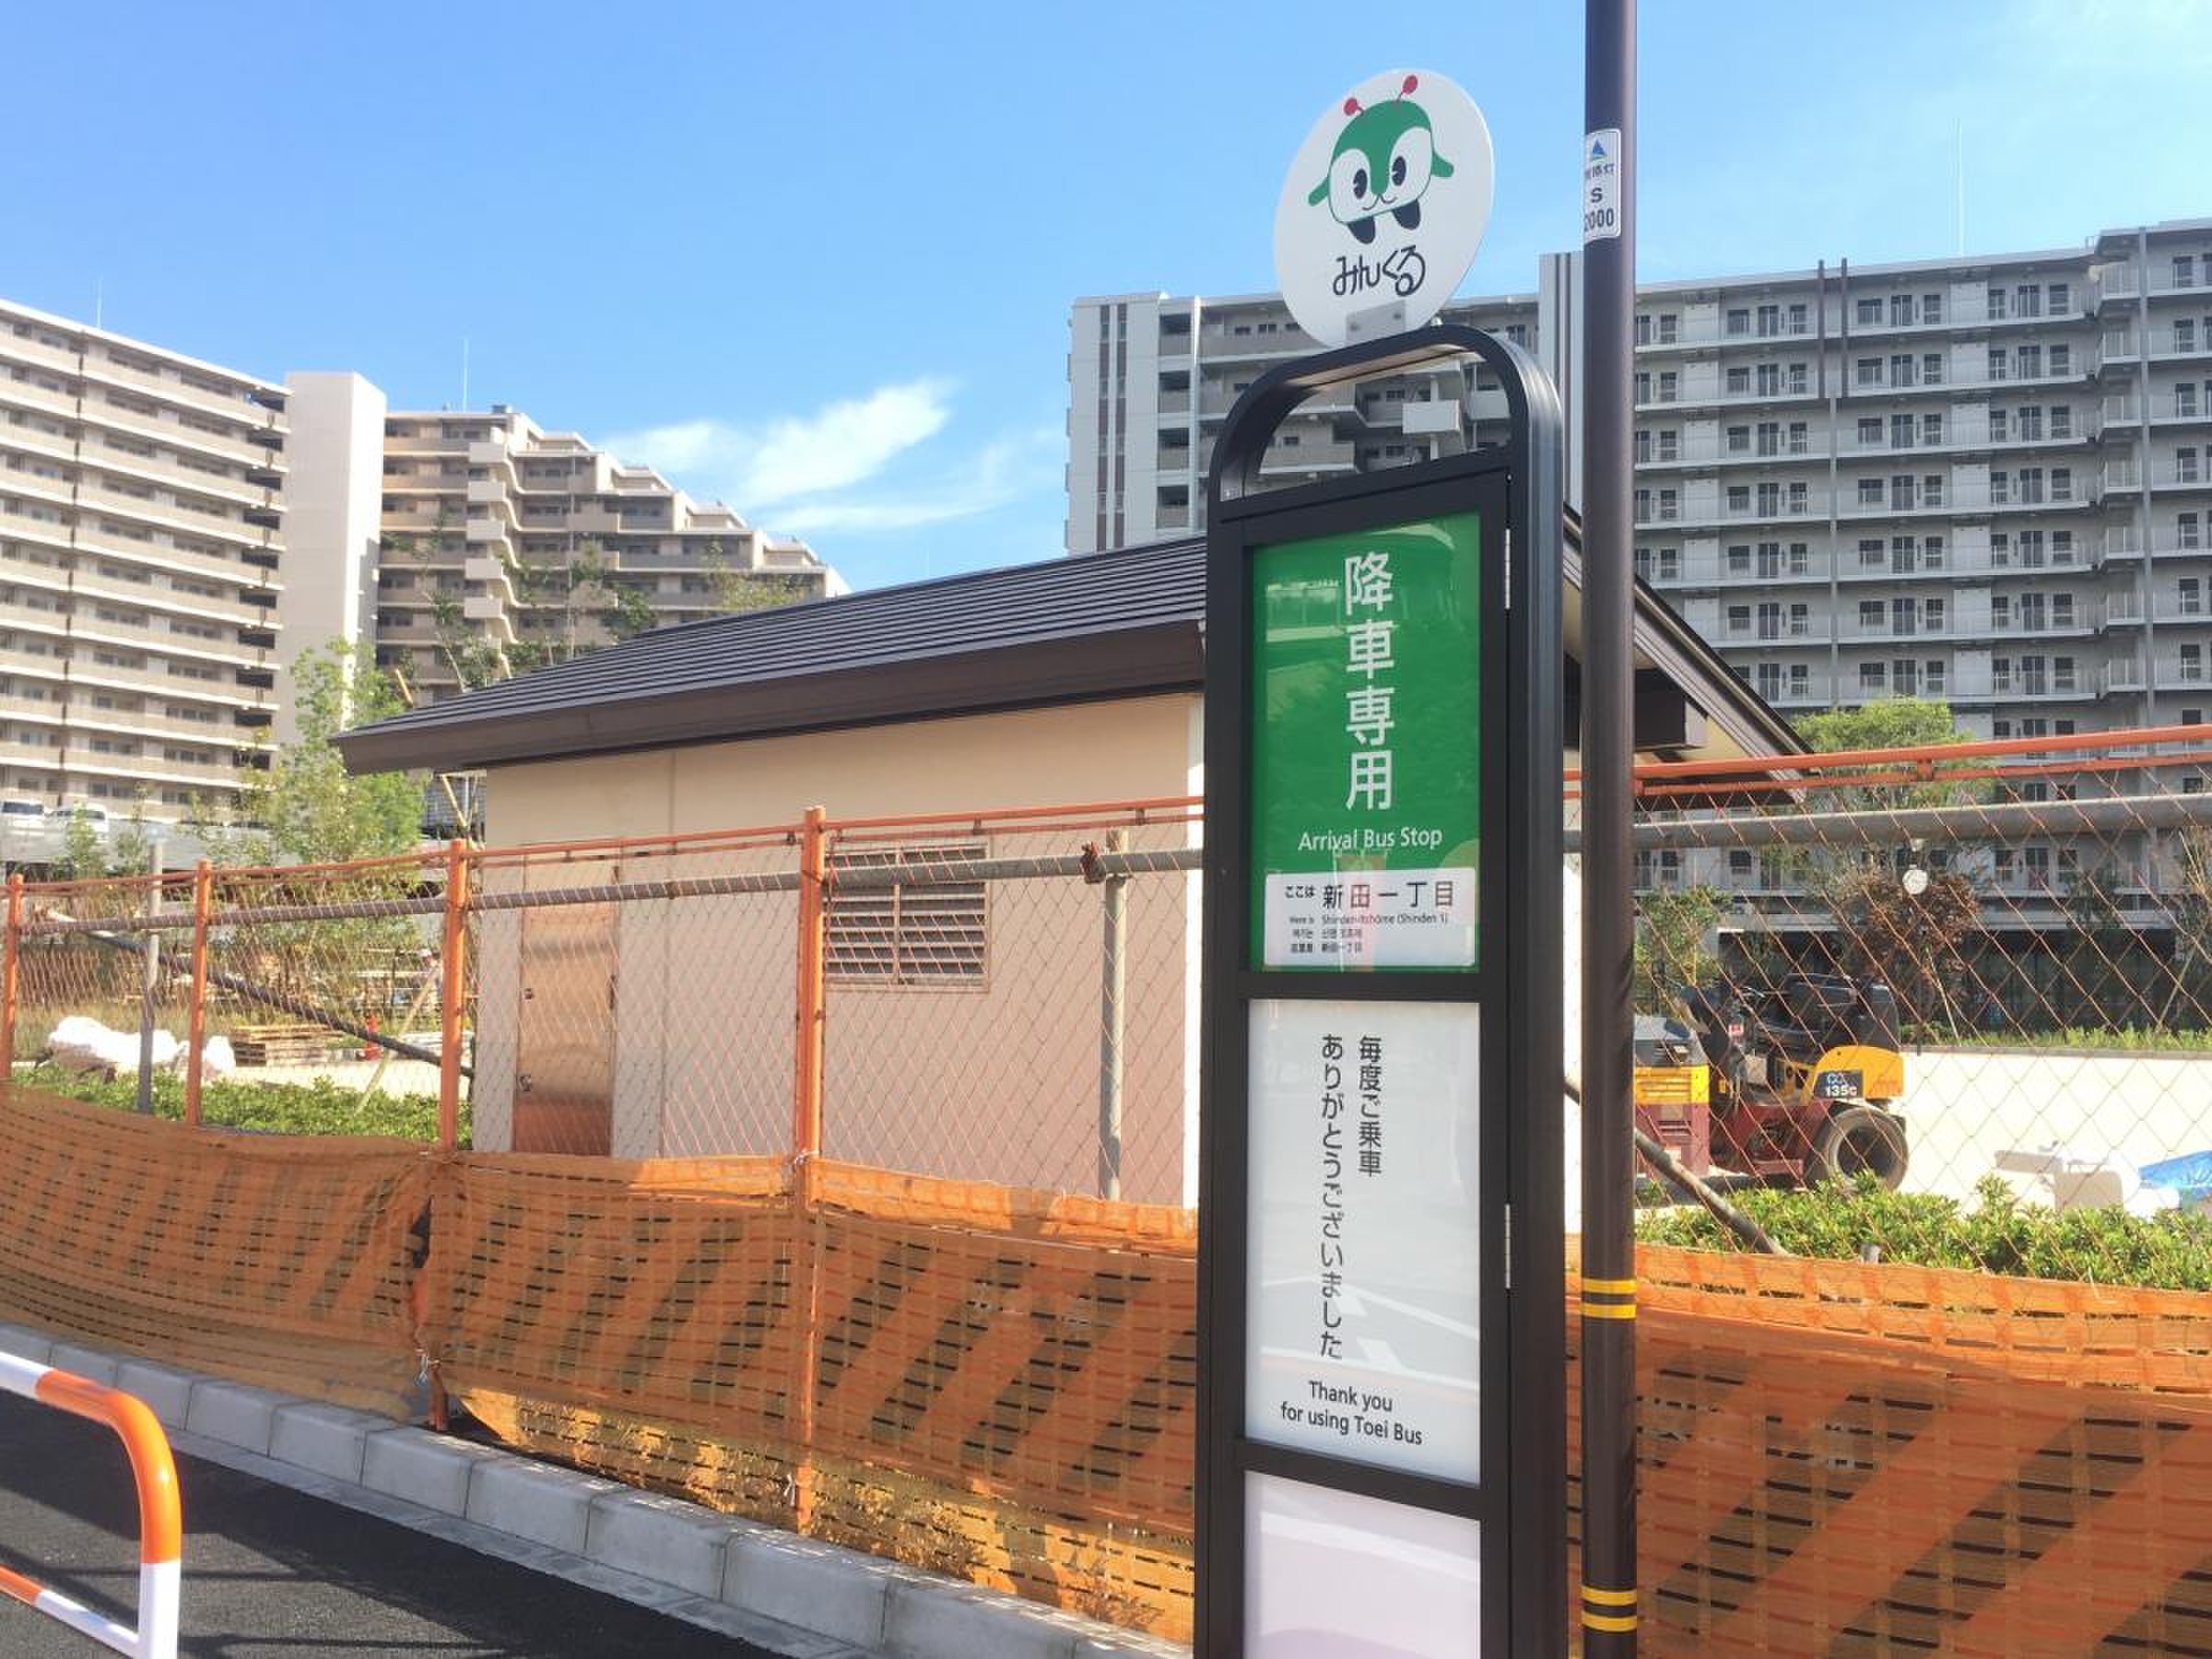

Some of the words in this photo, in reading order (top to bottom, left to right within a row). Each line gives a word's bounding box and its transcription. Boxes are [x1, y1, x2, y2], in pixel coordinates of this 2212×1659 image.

[1590, 186, 1604, 204] S
[1332, 244, 1427, 297] みんくる
[1343, 550, 1395, 812] 降車専用
[1298, 829, 1358, 852] Arrival
[1363, 829, 1395, 849] Bus
[1400, 826, 1442, 850] Stop
[1285, 884, 1315, 900] ここは
[1323, 880, 1453, 911] 新田一丁目
[1358, 1035, 1382, 1178] 毎度ご乗車
[1320, 1033, 1344, 1360] ありがとうございました
[1308, 1380, 1358, 1406] Thank
[1362, 1394, 1394, 1412] you
[1280, 1400, 1303, 1422] for
[1308, 1409, 1349, 1436] using
[1354, 1415, 1389, 1439] Toei
[1394, 1422, 1423, 1445] Bus
